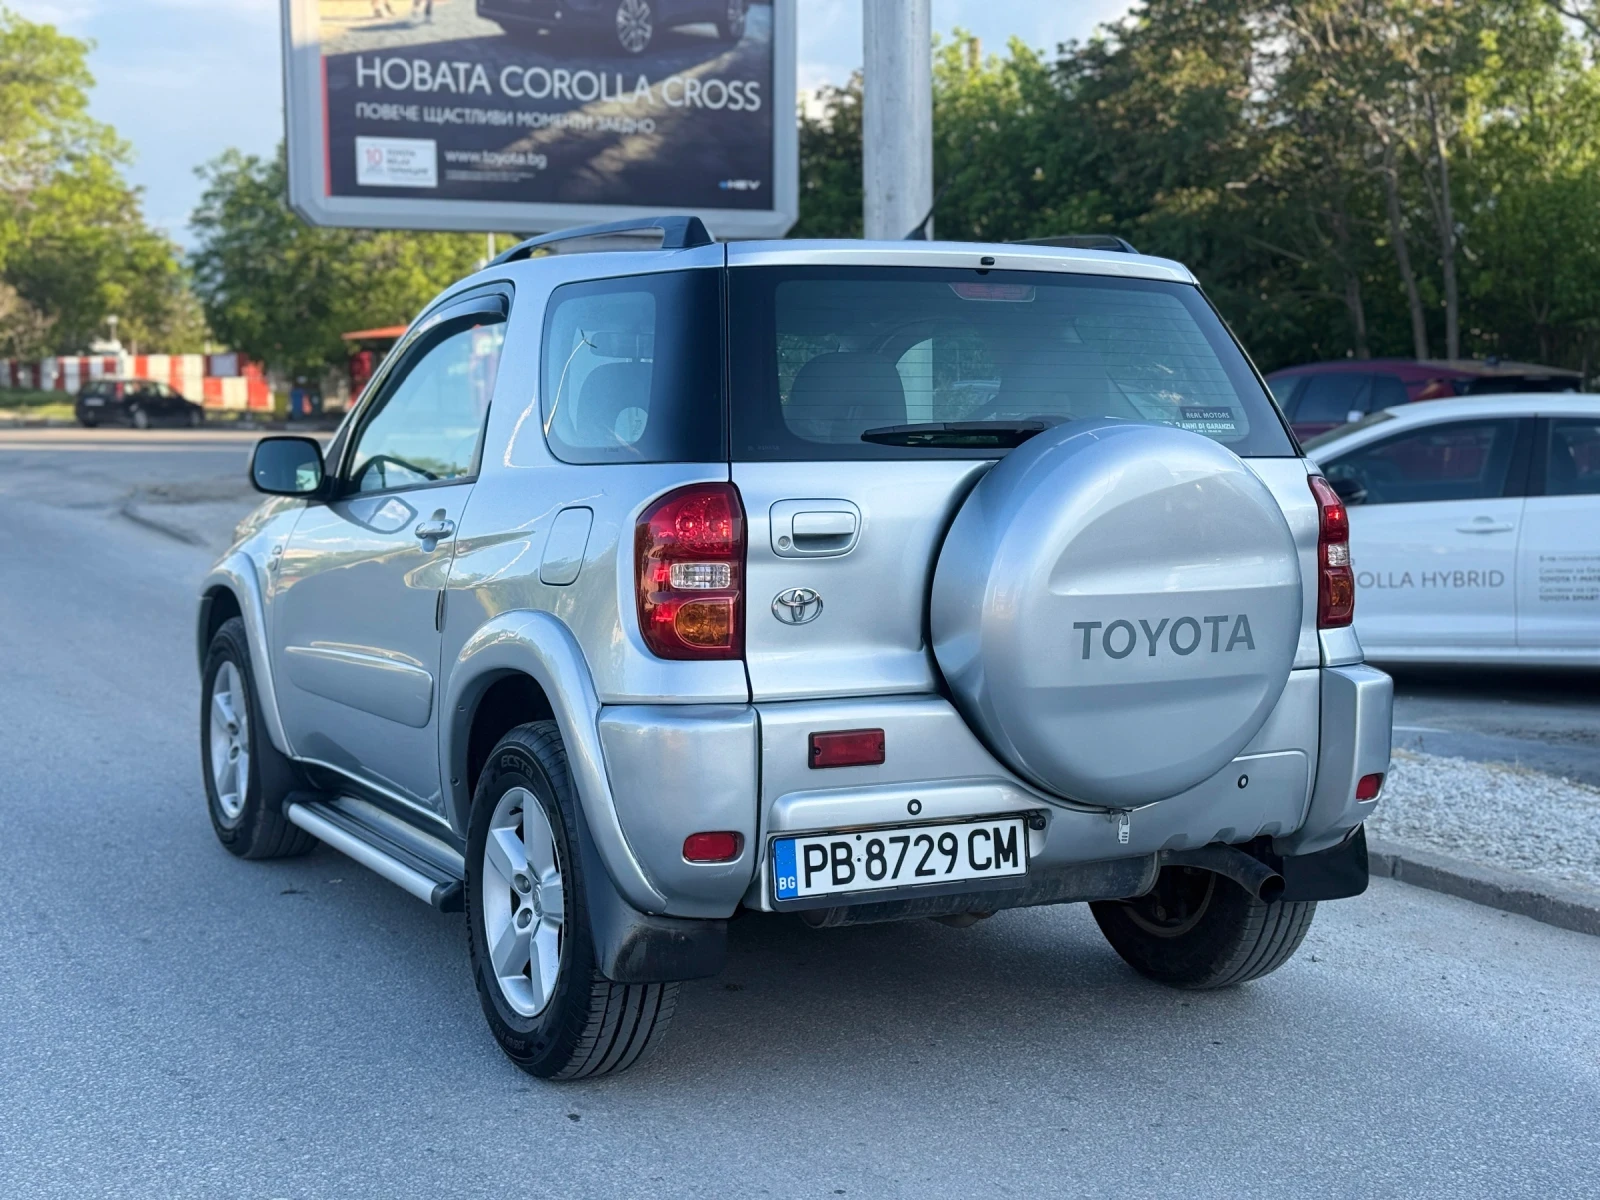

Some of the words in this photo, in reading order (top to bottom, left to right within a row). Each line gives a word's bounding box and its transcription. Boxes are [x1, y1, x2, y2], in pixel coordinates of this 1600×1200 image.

[356, 55, 492, 96] НОВАТА
[500, 65, 654, 104] COROLLA
[661, 76, 762, 112] CROSS
[356, 102, 421, 122] ПОВЕЧЕ
[423, 106, 513, 126] ЩАСТЛИВИ
[444, 149, 547, 169] www.toyota.bg
[1356, 571, 1415, 589] OLLA
[1422, 570, 1505, 588] HYBRID
[1073, 614, 1256, 660] TOYOTA
[803, 841, 855, 888] PB
[865, 832, 959, 881] 8729
[967, 826, 1019, 871] CM
[779, 876, 796, 891] BG
